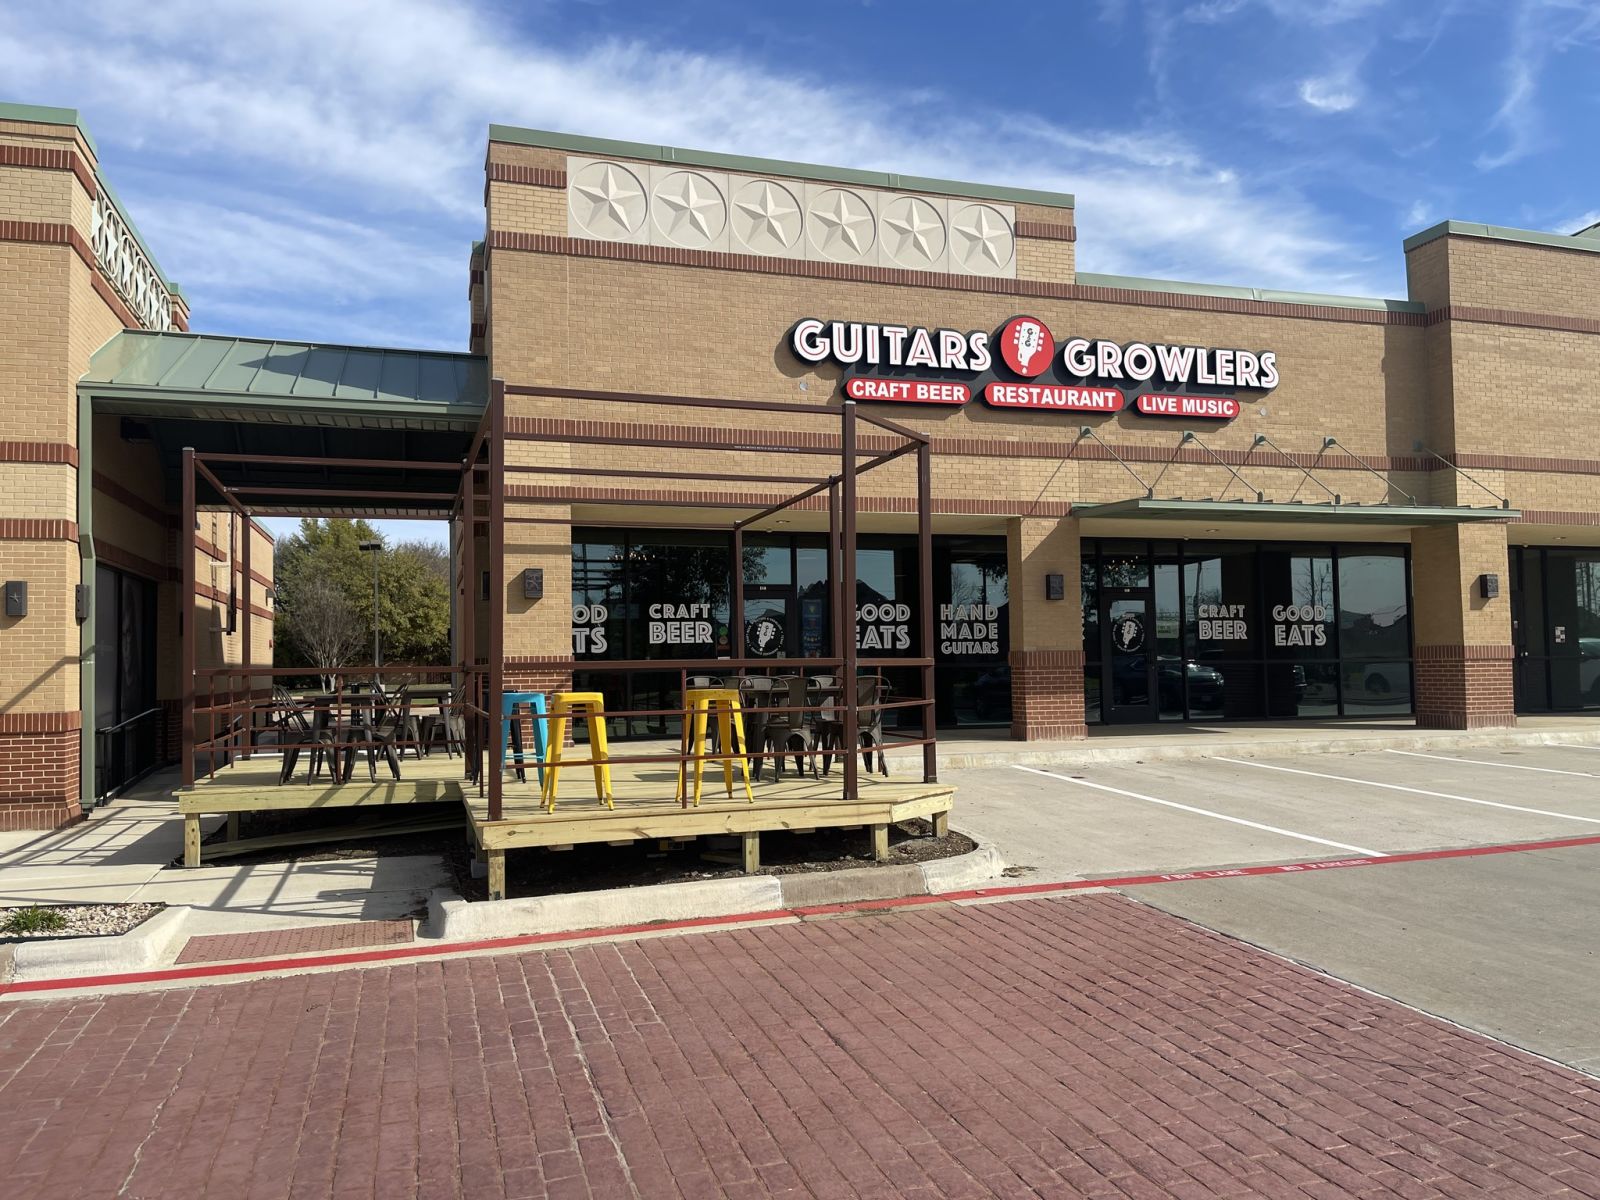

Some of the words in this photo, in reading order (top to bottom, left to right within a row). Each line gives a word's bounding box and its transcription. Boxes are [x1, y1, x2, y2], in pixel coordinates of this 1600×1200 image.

[794, 320, 991, 371] GUITARS
[1064, 339, 1280, 388] GROWLERS
[852, 381, 910, 398] CRAFT
[917, 383, 965, 401] BEER
[993, 386, 1116, 408] RESTAURANT
[1142, 397, 1177, 412] LIVE
[1183, 399, 1234, 415] MUSIC
[572, 604, 608, 624] OD
[649, 603, 711, 619] CRAFT
[940, 604, 998, 621] HAND
[1198, 604, 1246, 618] CRAFT
[1272, 605, 1326, 621] GOOD
[649, 622, 714, 644] BEER
[941, 622, 998, 639] MADE
[1198, 620, 1248, 640] BEER
[1274, 624, 1327, 646] EATS
[572, 627, 608, 654] TS
[941, 641, 999, 655] GUITARS
